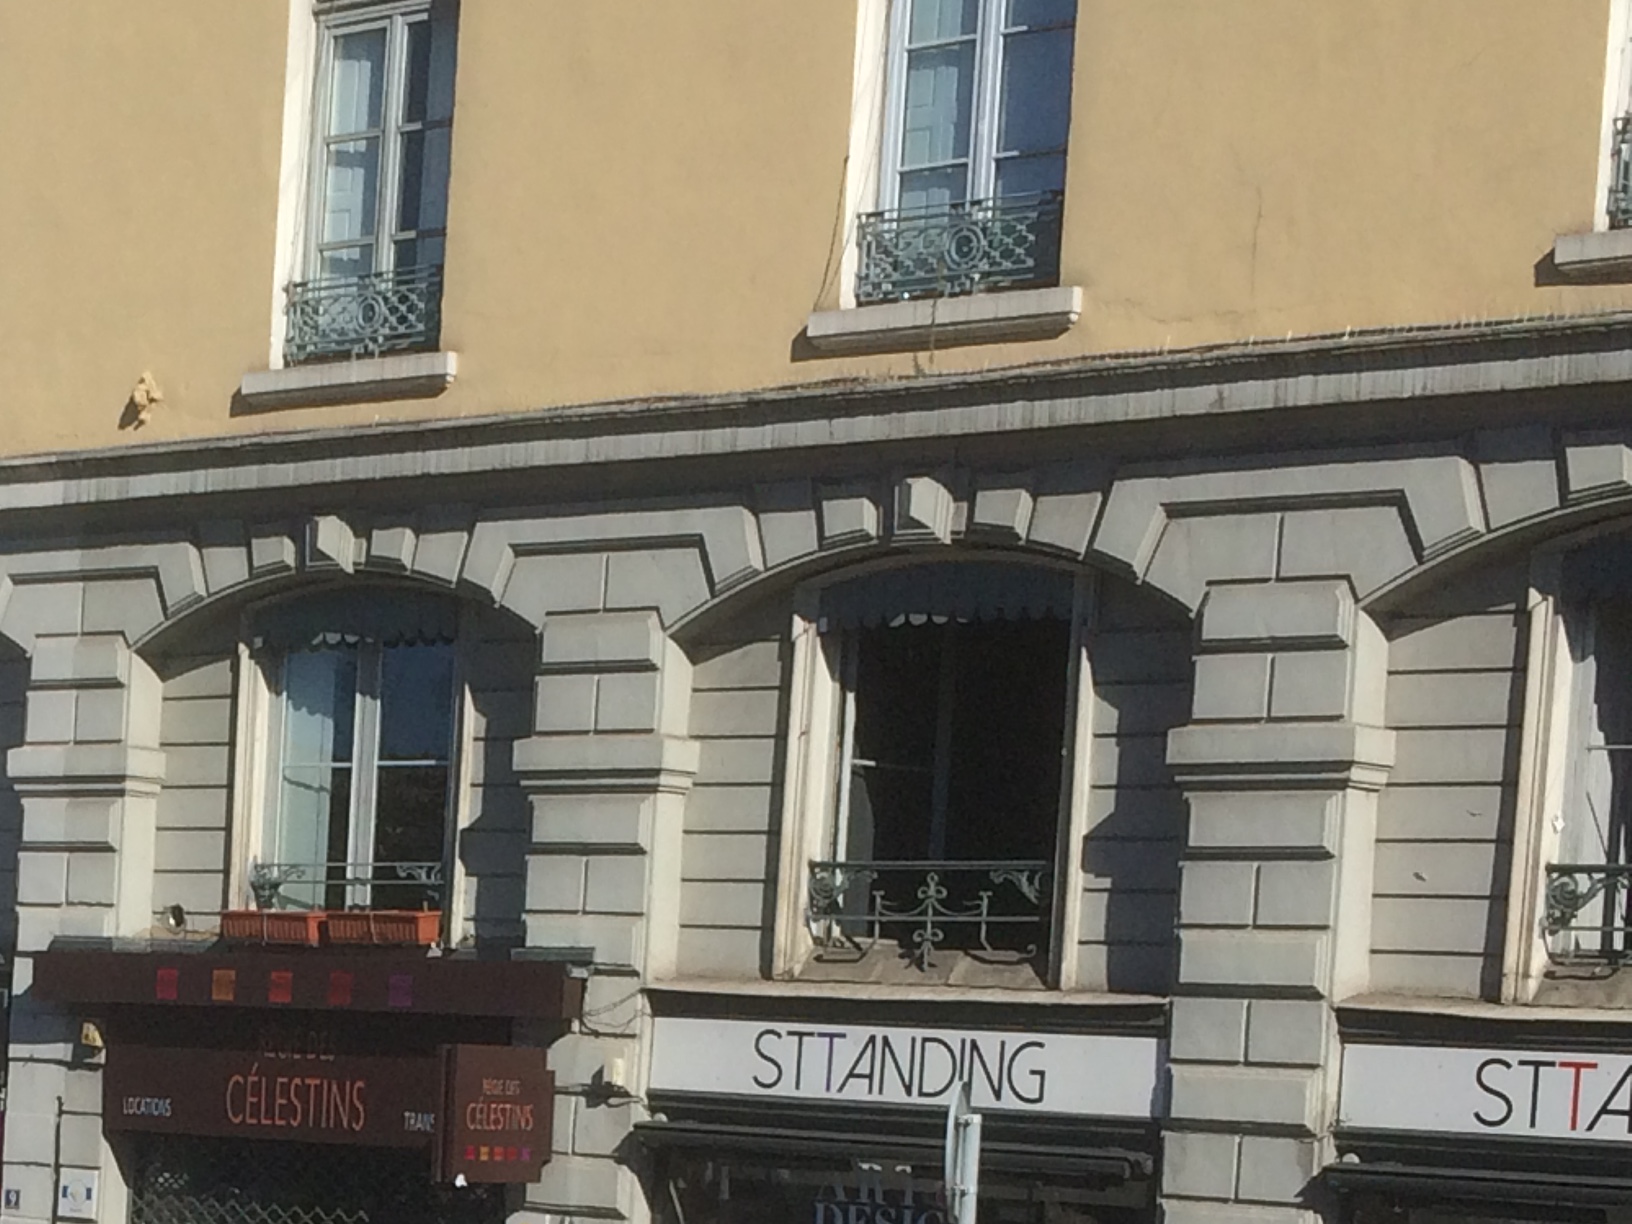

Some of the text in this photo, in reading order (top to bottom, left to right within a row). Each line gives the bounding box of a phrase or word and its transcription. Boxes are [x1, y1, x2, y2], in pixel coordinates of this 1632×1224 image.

[752, 1029, 1046, 1104] STTANDING
[122, 1096, 172, 1117] LOCATIONS
[225, 1062, 366, 1132] CÉLESTINS
[466, 1096, 535, 1131] CÉLESTINS
[1473, 1058, 1632, 1134] STTA
[9, 1190, 17, 1207] 9
